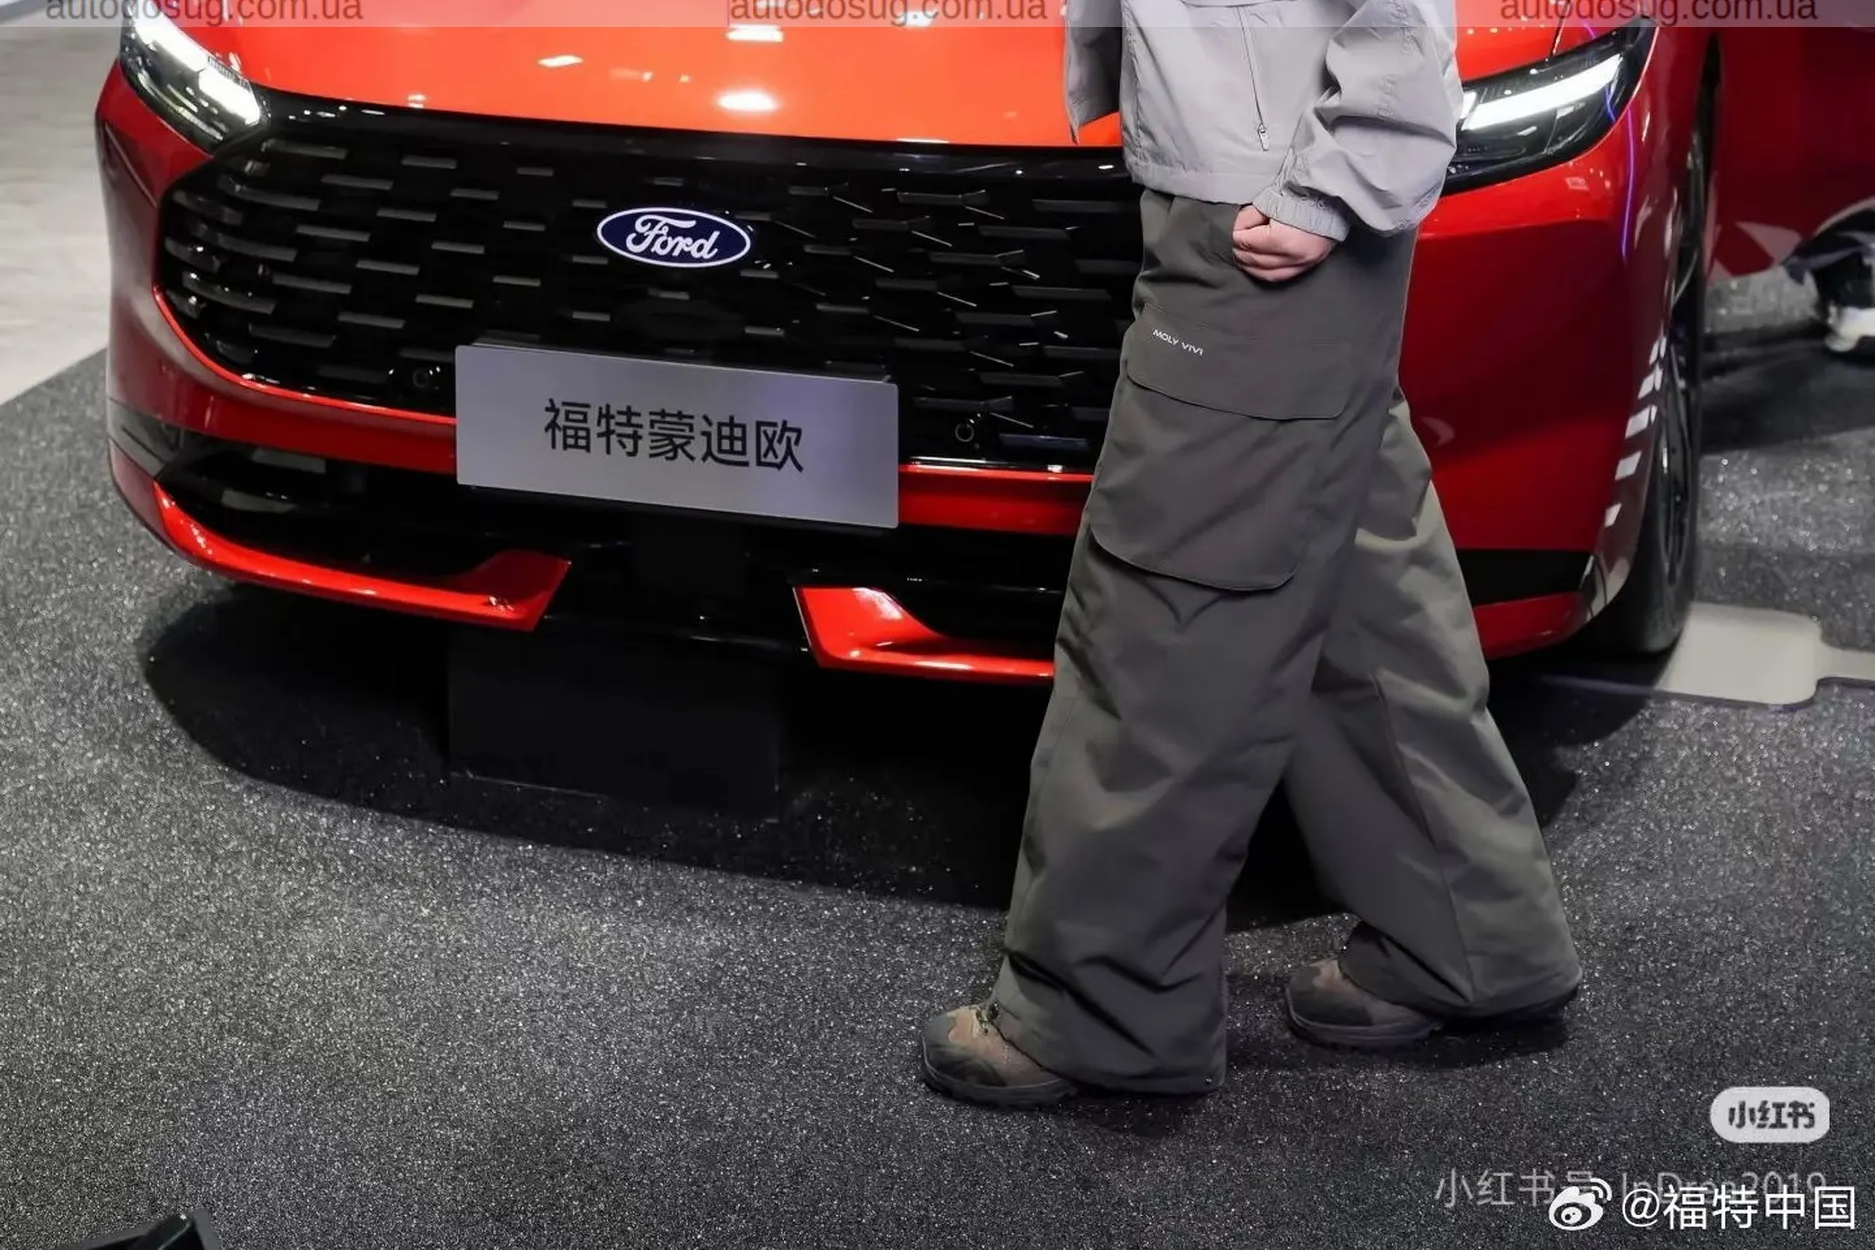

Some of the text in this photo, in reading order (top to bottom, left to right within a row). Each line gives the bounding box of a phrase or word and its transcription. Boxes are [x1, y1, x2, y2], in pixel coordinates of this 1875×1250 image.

[626, 214, 720, 259] Ford
[544, 398, 804, 473] 福特蒙迪欧
